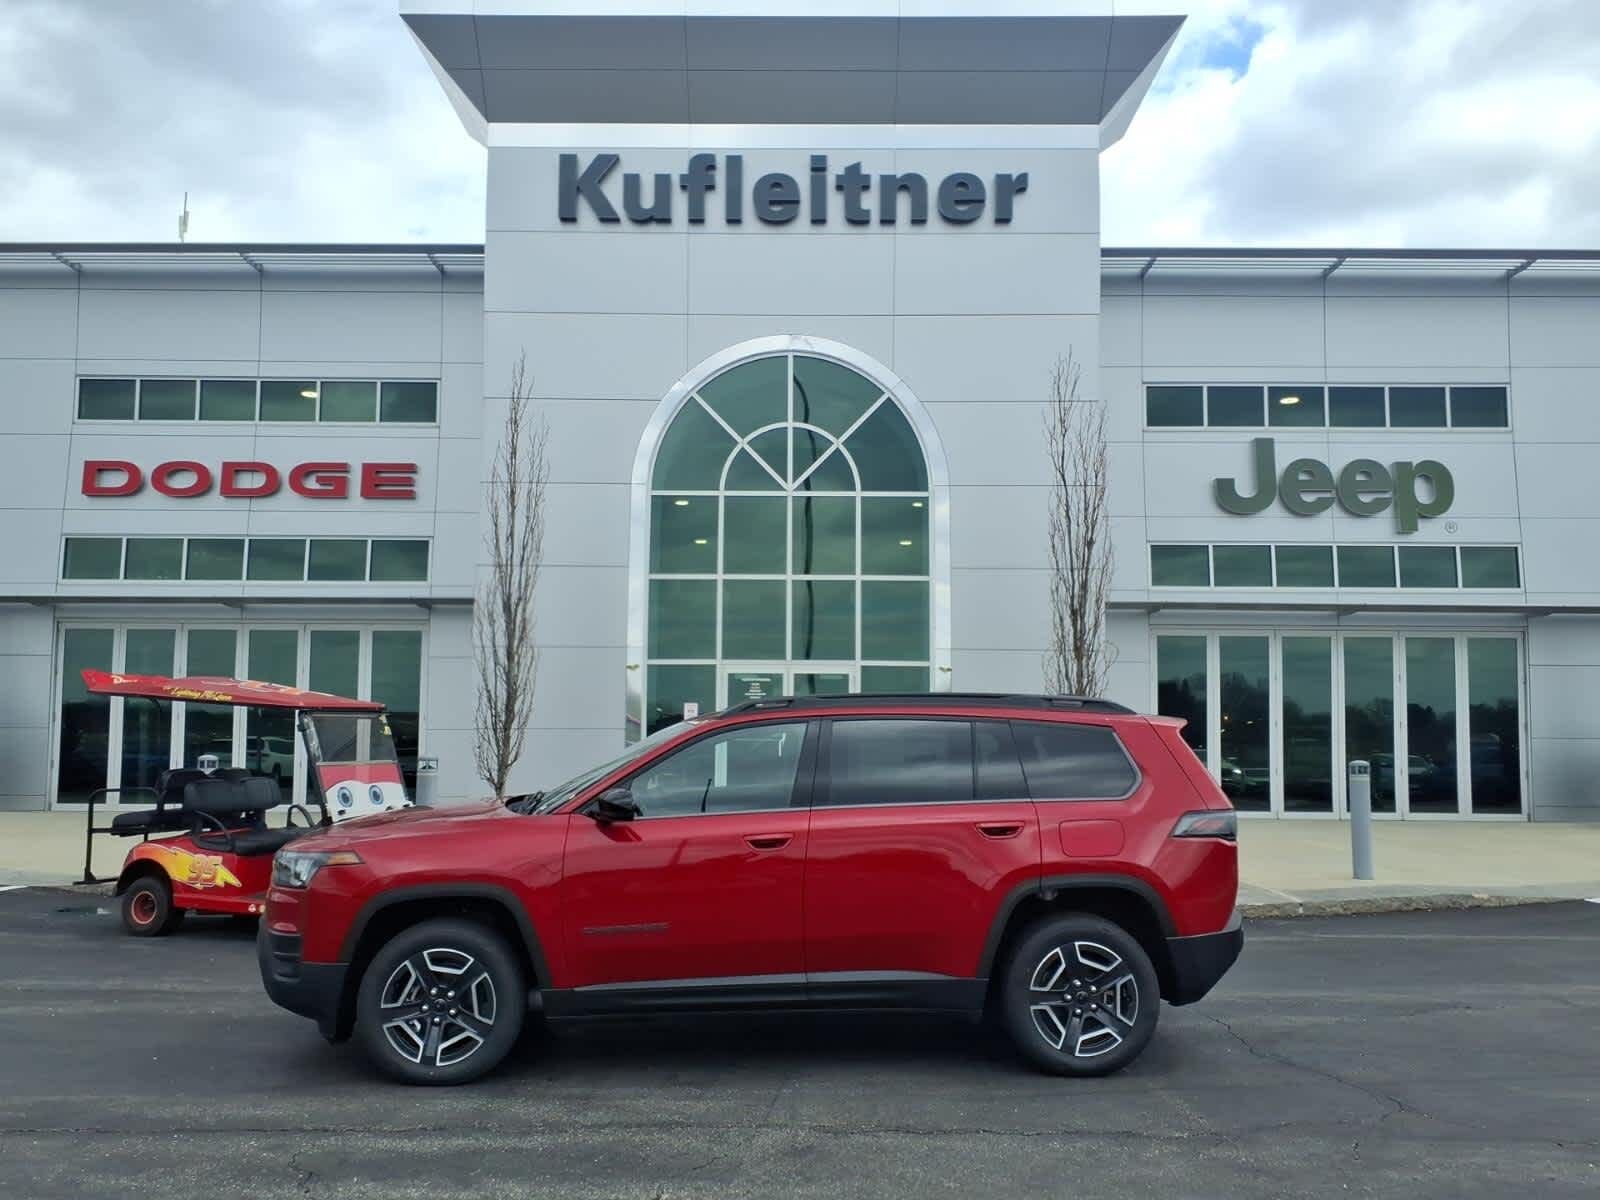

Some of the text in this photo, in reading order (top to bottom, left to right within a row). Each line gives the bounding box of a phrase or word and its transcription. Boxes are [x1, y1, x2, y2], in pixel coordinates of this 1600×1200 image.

[558, 153, 1029, 225] Kufleitner
[81, 460, 418, 500] DODGE
[1213, 437, 1455, 535] Jeep
